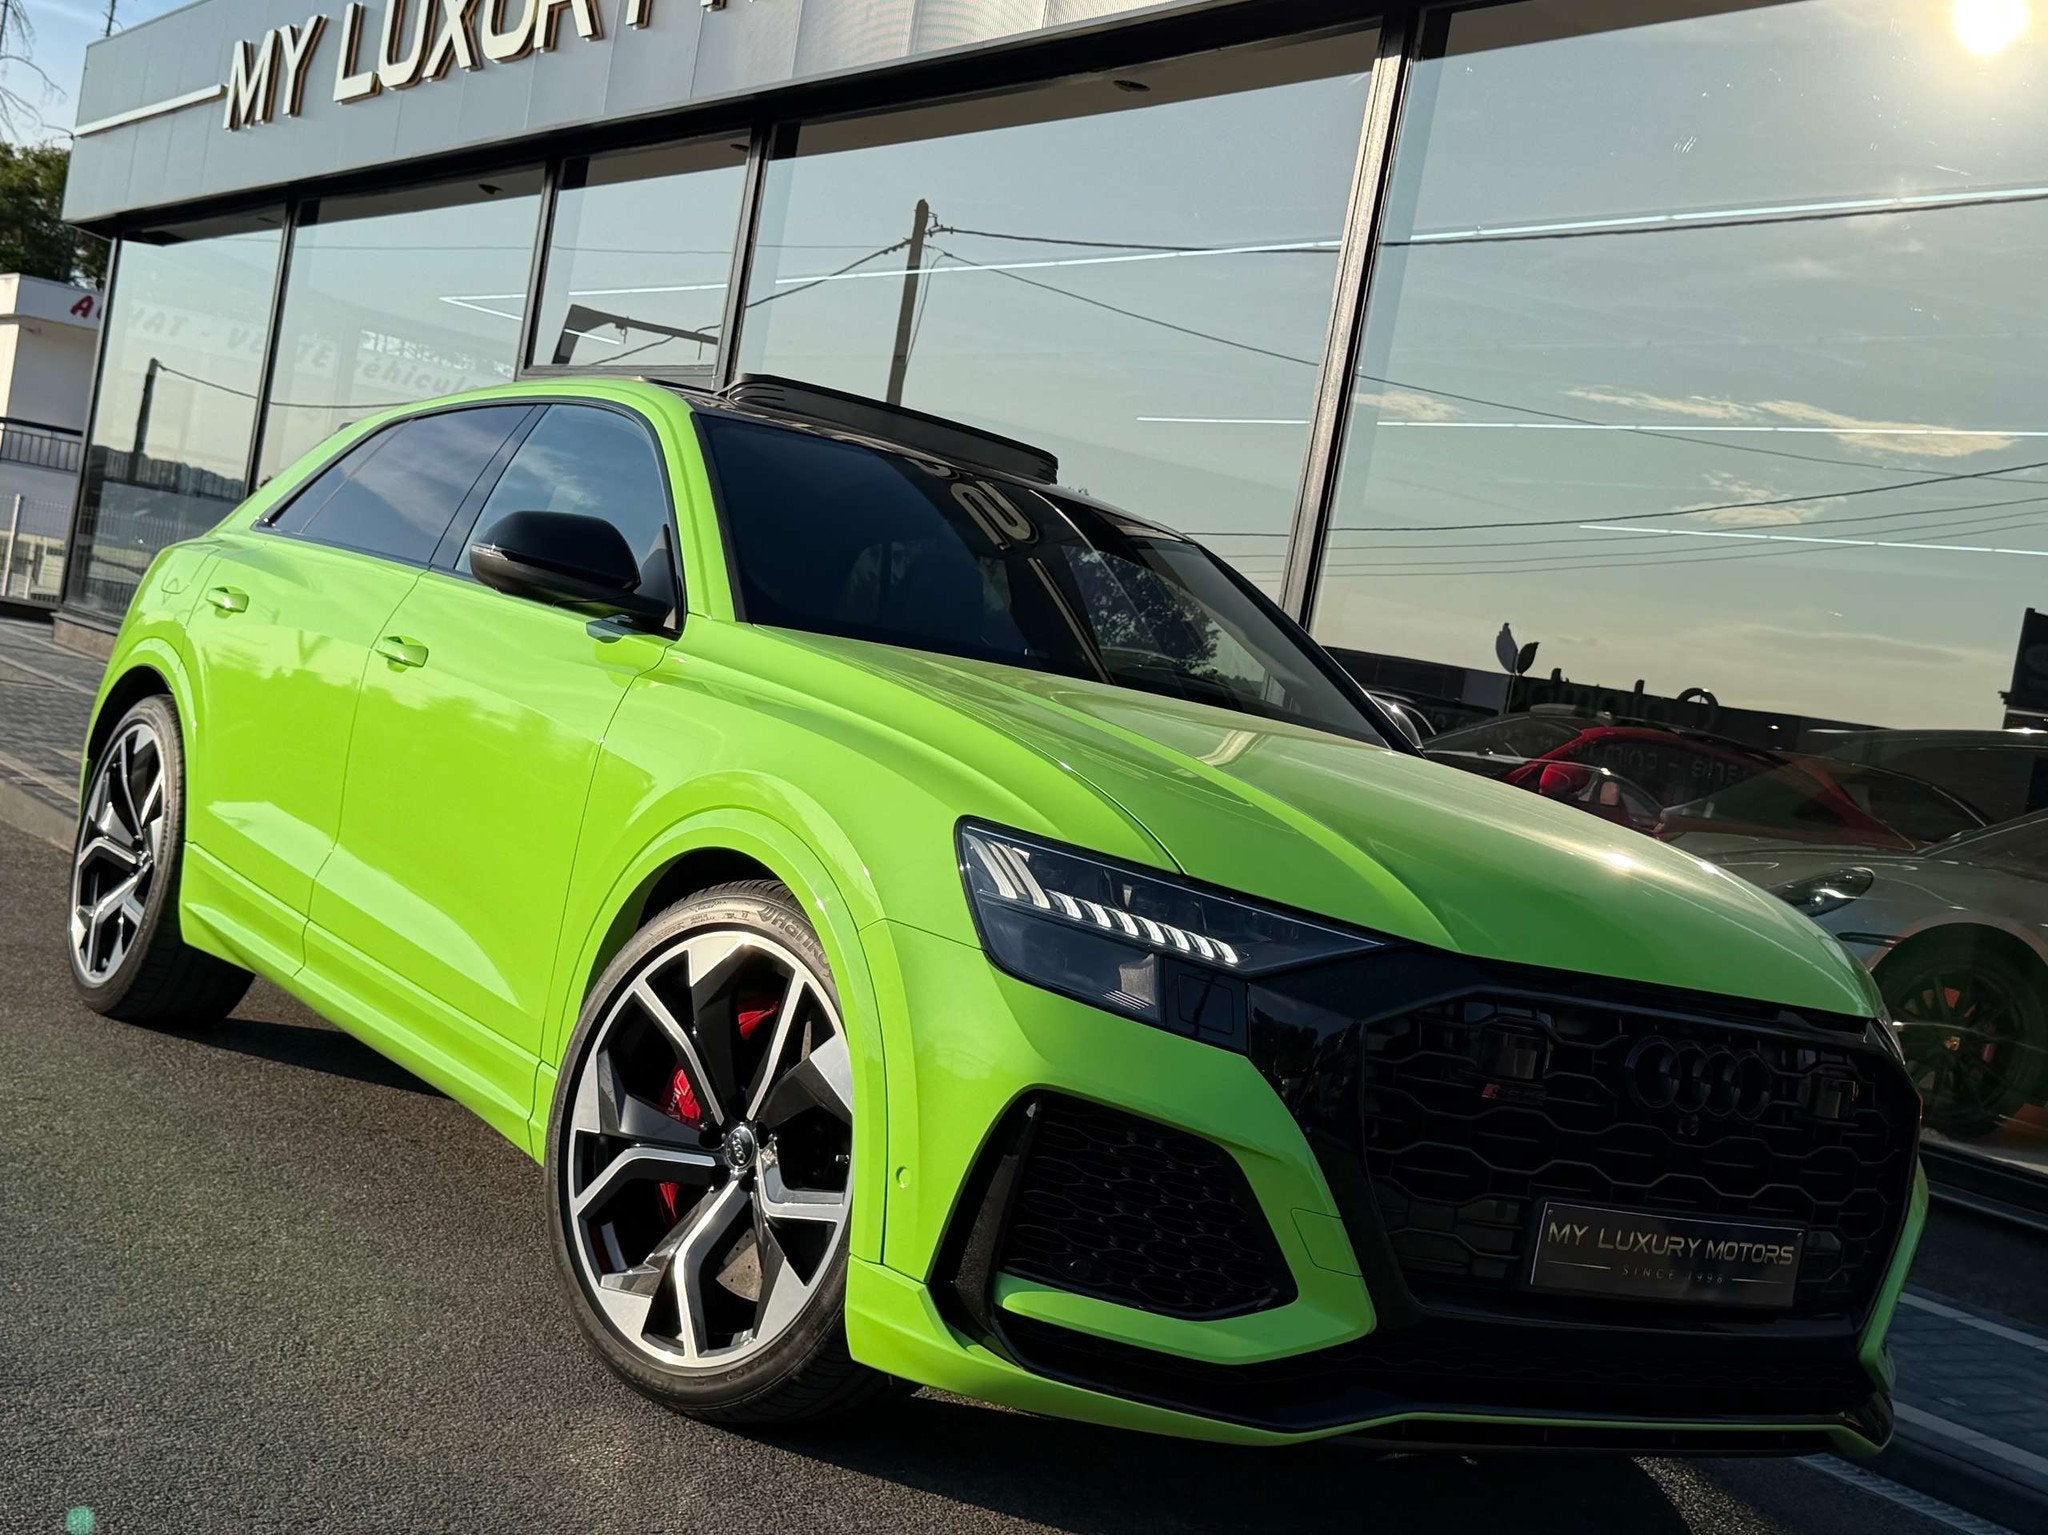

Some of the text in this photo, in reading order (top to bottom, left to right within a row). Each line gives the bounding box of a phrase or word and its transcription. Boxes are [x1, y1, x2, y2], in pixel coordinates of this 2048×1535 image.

[222, 14, 328, 131] MY
[1547, 1222, 1795, 1266] MY LUXURY MOTORS
[1622, 1266, 1676, 1281] SINCE
